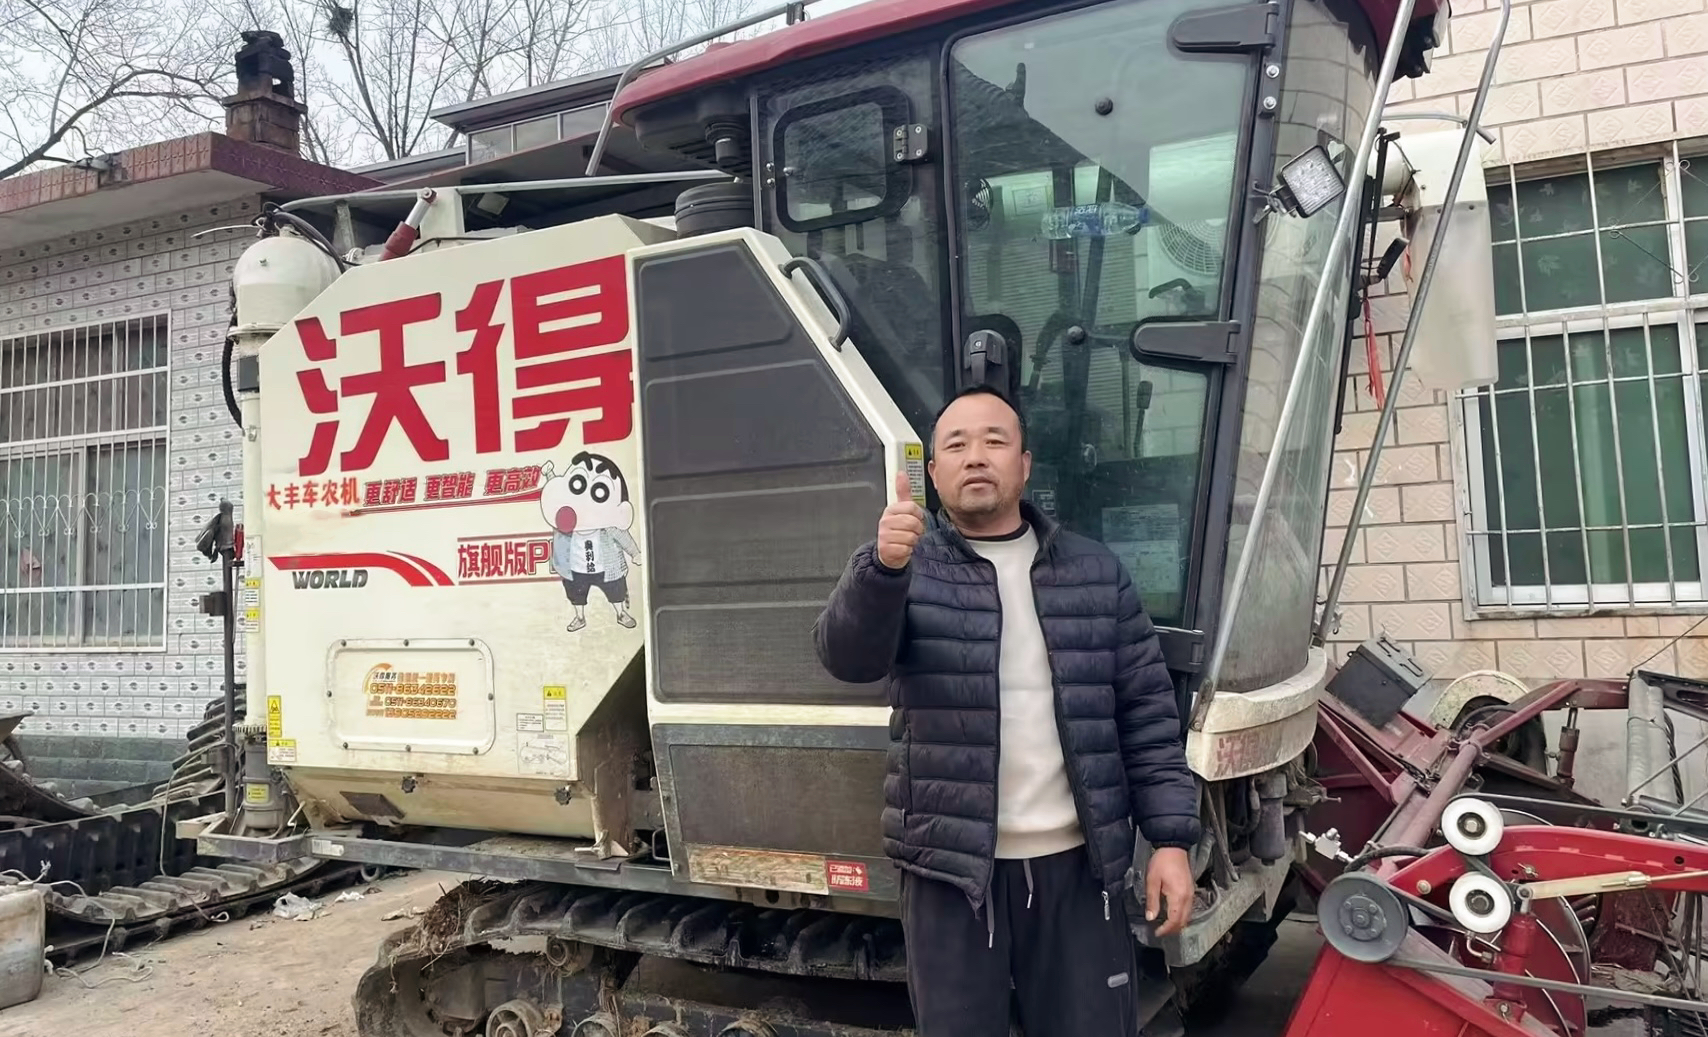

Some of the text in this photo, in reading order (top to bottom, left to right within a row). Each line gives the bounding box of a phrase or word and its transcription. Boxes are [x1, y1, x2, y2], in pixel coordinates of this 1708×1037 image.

[295, 254, 634, 476] 沃得
[267, 478, 360, 510] 大丰车农机
[364, 465, 541, 506] 更舒适 更智能 更高效
[457, 539, 556, 578] 旗舰版P
[292, 569, 369, 589] WORLD
